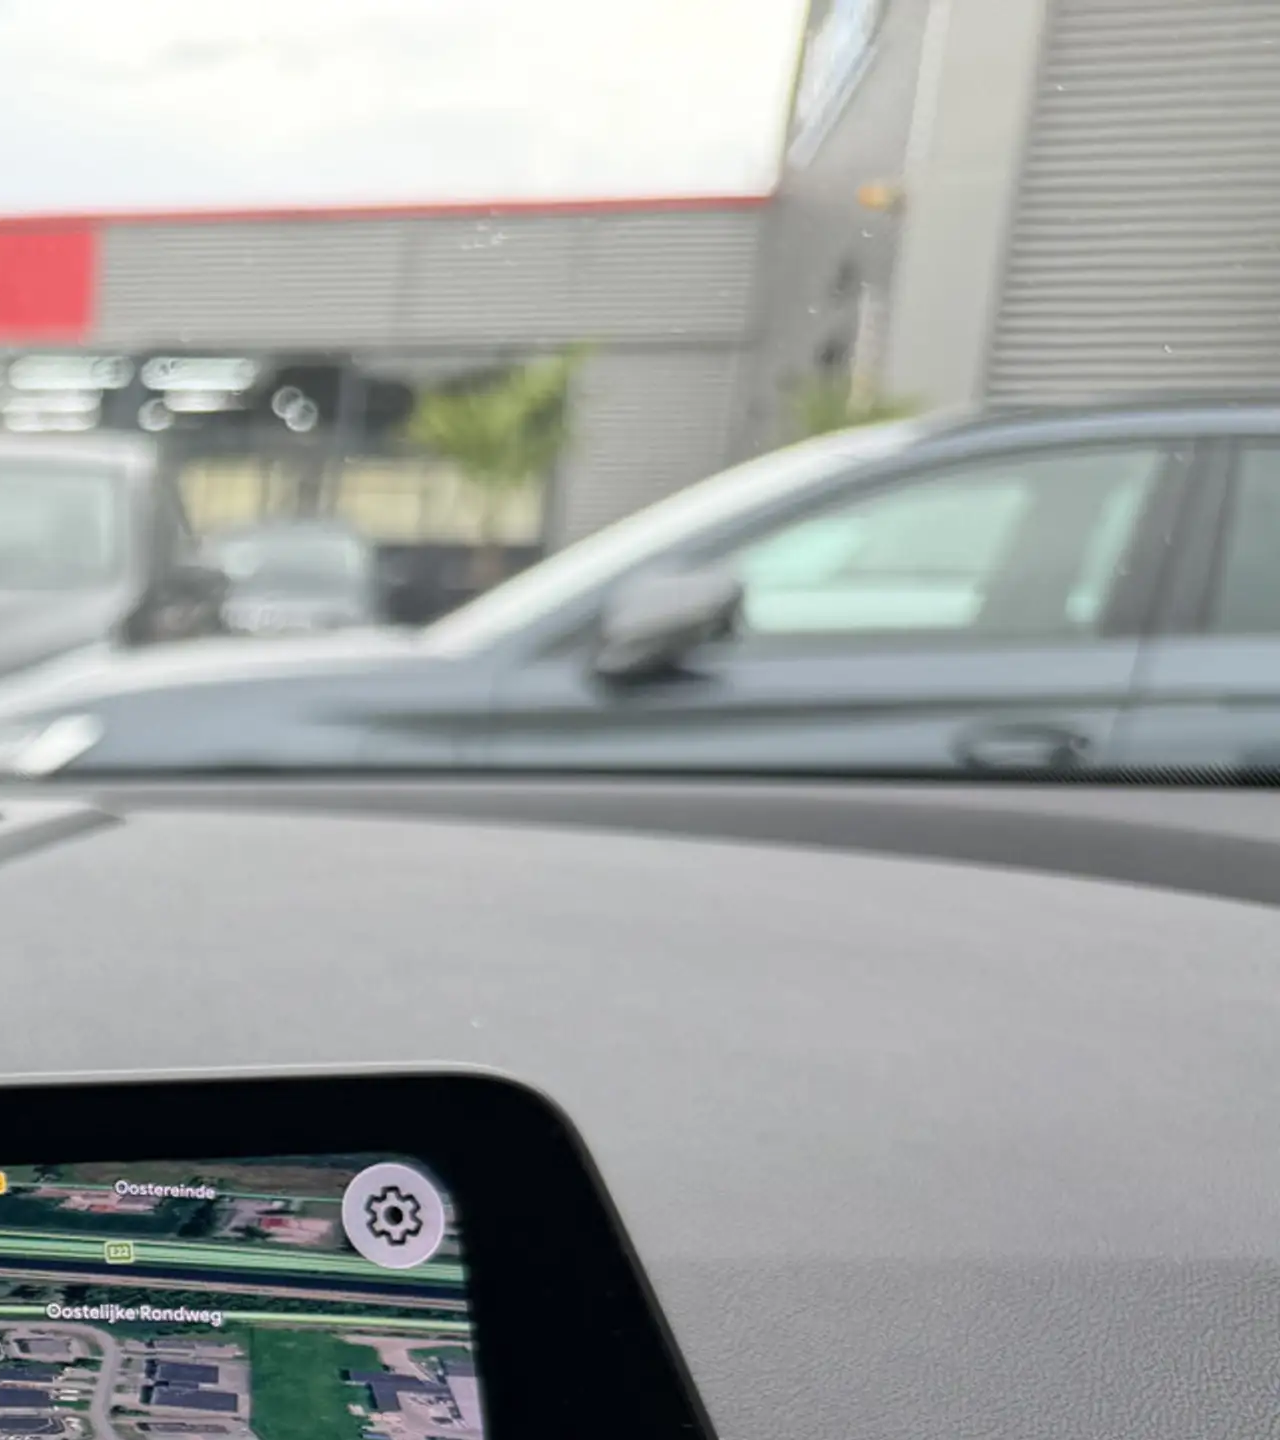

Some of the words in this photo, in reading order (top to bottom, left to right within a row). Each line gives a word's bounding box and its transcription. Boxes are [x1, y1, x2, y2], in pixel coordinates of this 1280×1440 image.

[115, 1180, 216, 1200] Oostereinde
[46, 1303, 135, 1324] Oostelijke
[140, 1305, 223, 1327] Rondweg
